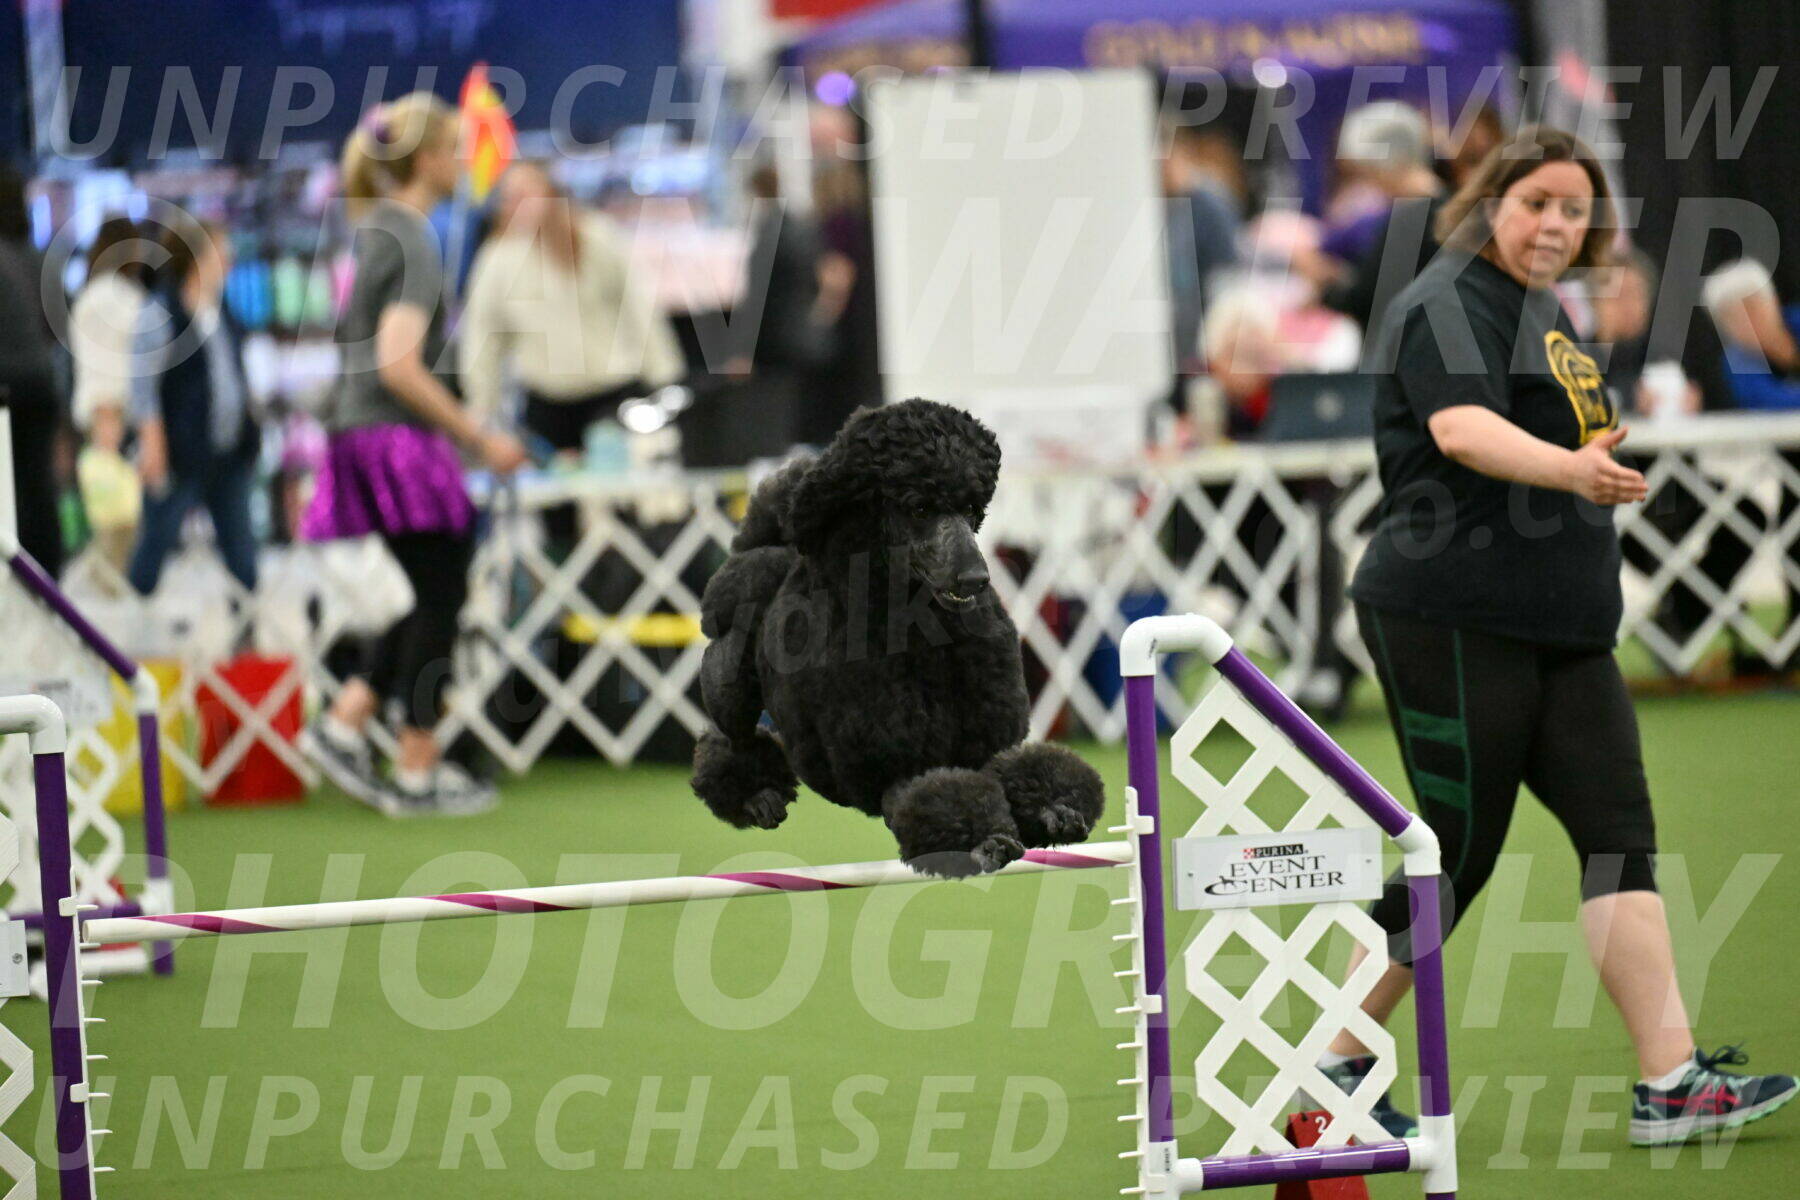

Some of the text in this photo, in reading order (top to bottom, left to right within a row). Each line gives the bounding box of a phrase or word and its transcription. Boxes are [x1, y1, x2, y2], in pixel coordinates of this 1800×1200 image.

[1255, 844, 1303, 858] PURINA
[1231, 855, 1325, 877] EVENT
[1204, 872, 1345, 895] CENTER
